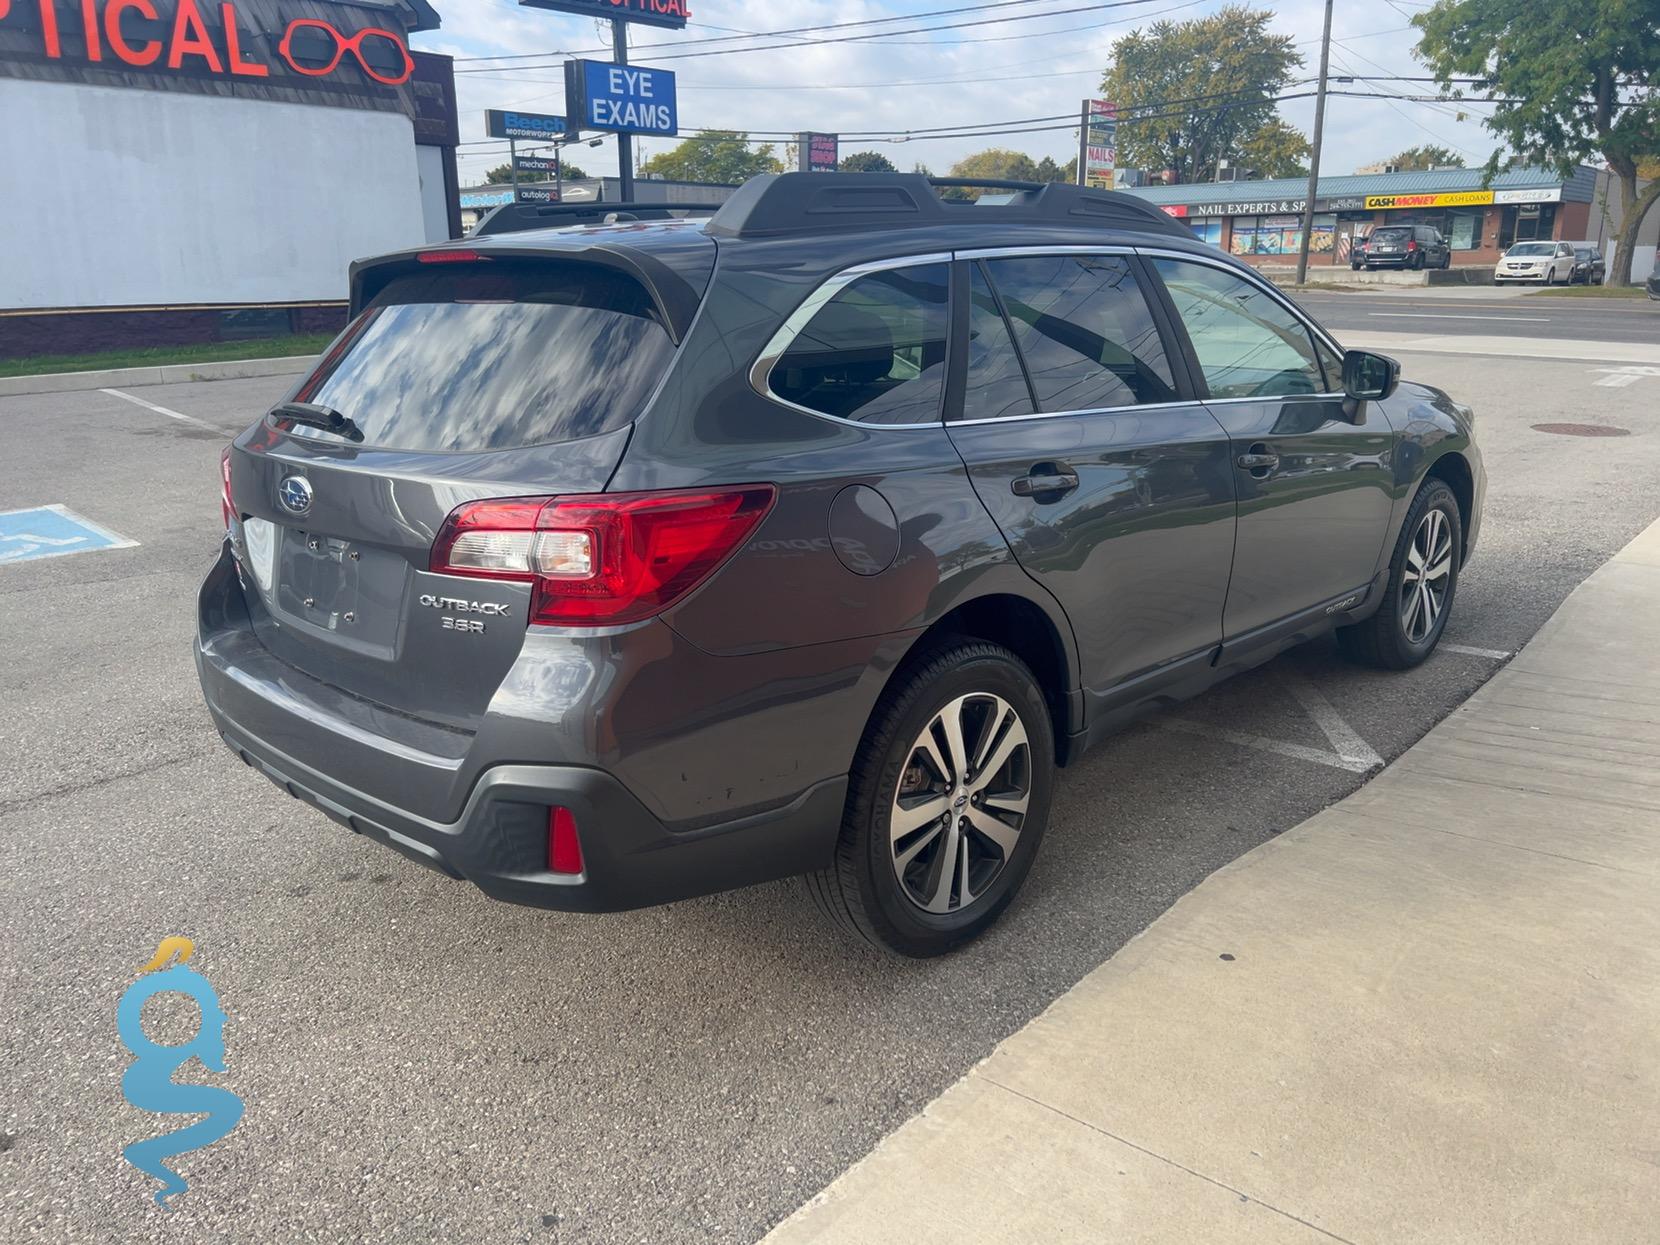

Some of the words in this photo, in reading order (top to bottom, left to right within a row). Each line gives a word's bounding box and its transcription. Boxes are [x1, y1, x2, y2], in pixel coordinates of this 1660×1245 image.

[610, 0, 692, 18] ICAL
[0, 0, 269, 77] TICAL
[608, 68, 653, 97] EYE
[504, 112, 566, 132] Beech
[592, 98, 671, 131] EXAMS
[1088, 147, 1114, 163] NAILS
[1198, 204, 1225, 215] NAIL
[1227, 202, 1277, 214] EXPERTS
[1279, 201, 1289, 212] &
[1292, 201, 1308, 212] SP
[419, 594, 512, 617] OUTBACK
